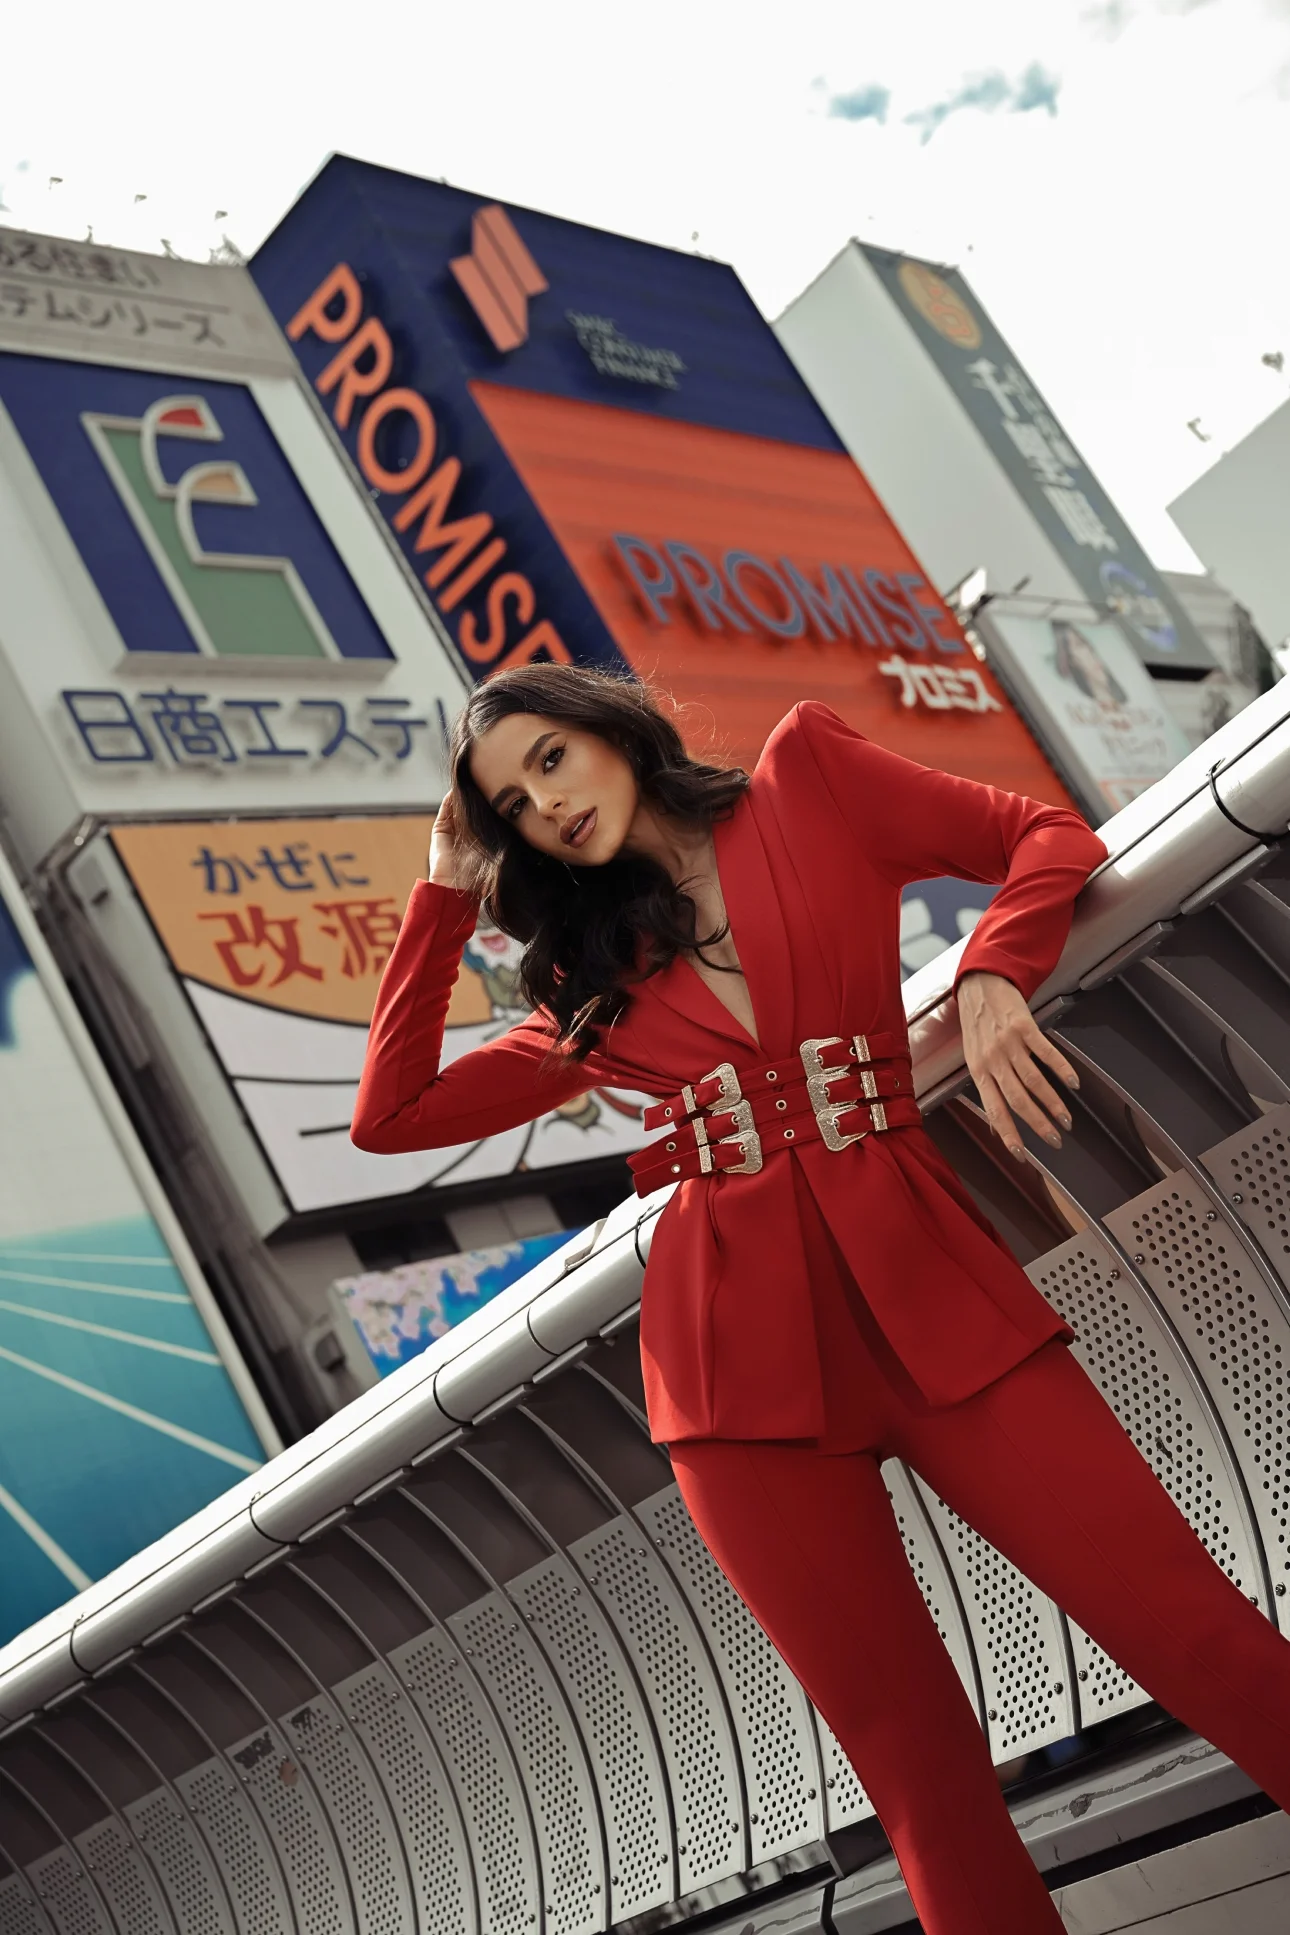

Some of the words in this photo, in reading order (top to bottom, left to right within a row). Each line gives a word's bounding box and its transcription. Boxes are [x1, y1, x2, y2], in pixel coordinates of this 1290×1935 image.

[613, 532, 966, 654] PROMISE
[192, 843, 370, 895] かぜに
